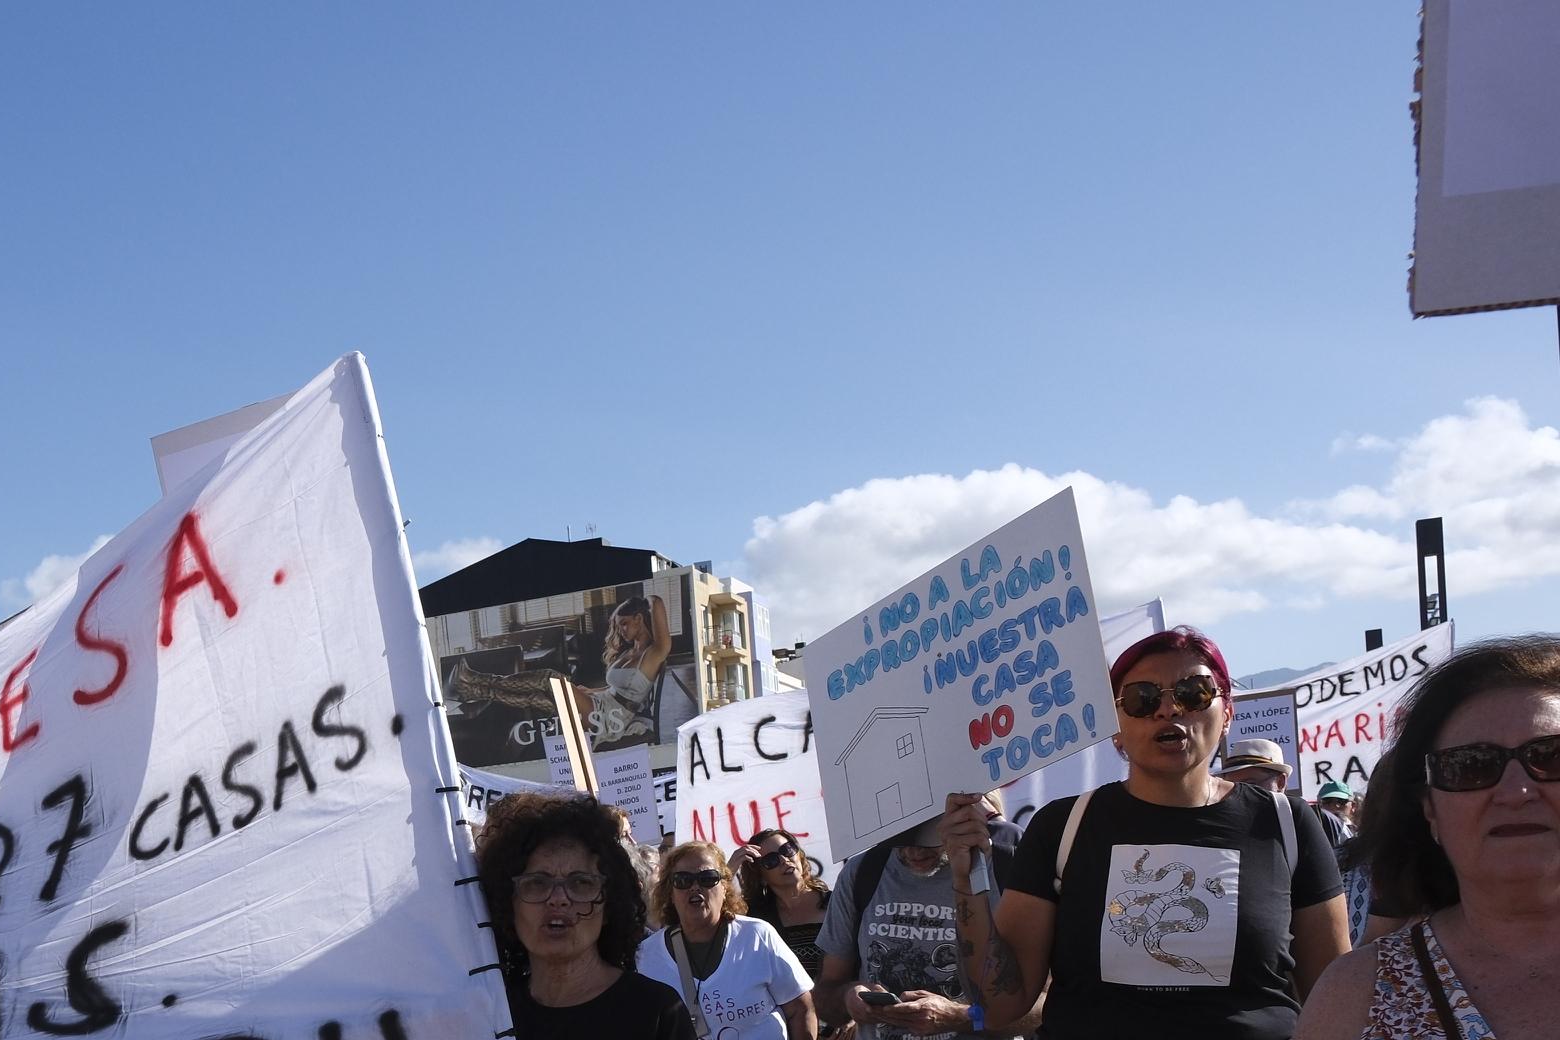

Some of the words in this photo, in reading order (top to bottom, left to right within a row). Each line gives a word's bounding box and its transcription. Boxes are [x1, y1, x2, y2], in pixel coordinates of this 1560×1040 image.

[827, 545, 1072, 700] EXPROPIACIÓN!
[863, 592, 920, 644] ¡NO
[929, 575, 949, 610] A
[961, 545, 1002, 590] LA
[924, 586, 1088, 693] ¡NUESTRA
[972, 640, 1059, 706] CASA
[969, 704, 1014, 750] NO
[1029, 670, 1075, 718] SE
[1241, 723, 1278, 734] UNIDOS
[1262, 707, 1290, 717] LÓPEZ
[614, 763, 638, 773] BARRIO
[981, 703, 1096, 782] TOCA!
[129, 683, 406, 861] CASAS.
[625, 784, 641, 793] ZOILO
[615, 796, 639, 806] UNIDOS
[634, 806, 648, 815] MÁS
[692, 790, 824, 846] NUE
[875, 903, 957, 919] SUPPOR
